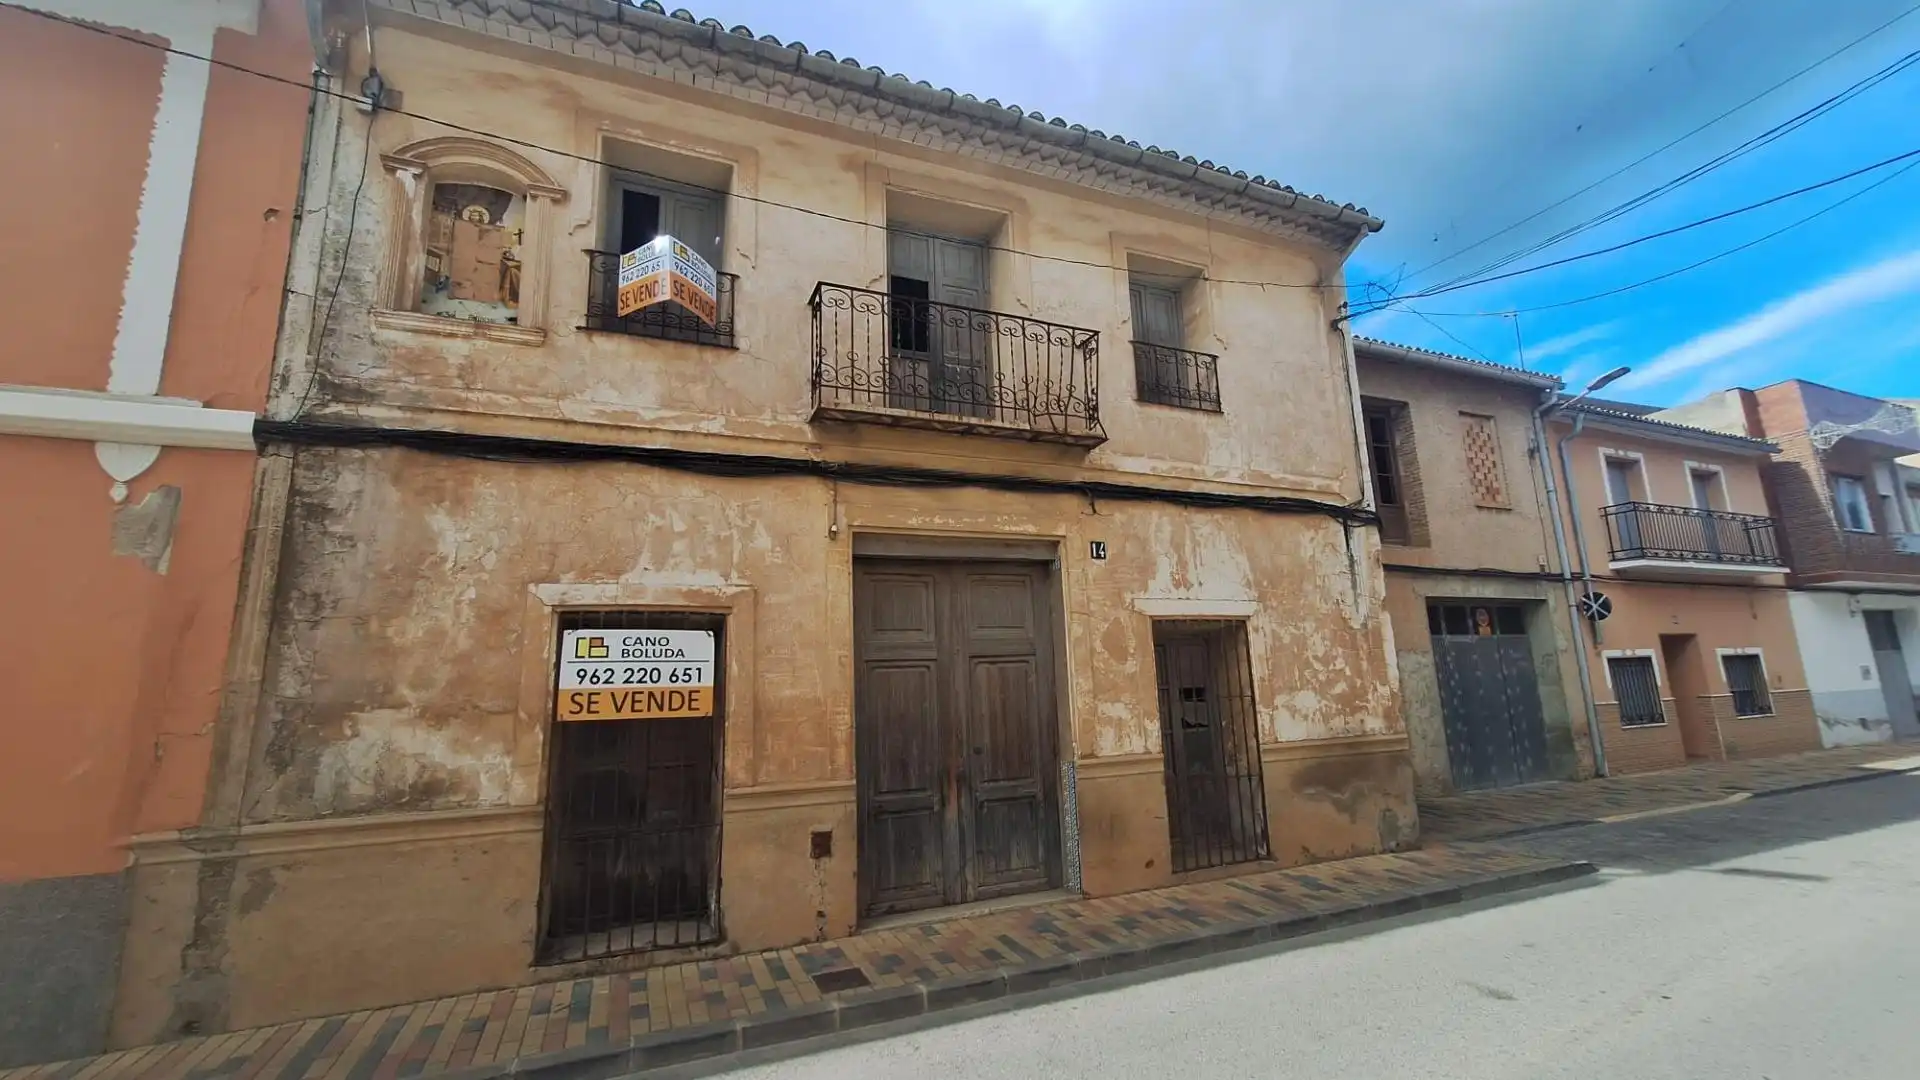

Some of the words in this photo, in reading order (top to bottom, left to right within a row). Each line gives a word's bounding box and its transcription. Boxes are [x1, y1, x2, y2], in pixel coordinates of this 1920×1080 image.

[622, 270, 634, 284] 962
[635, 265, 650, 279] 220
[674, 261, 688, 278] 962
[690, 271, 703, 287] 220
[620, 291, 631, 310] SE
[631, 278, 666, 304] VENDE
[673, 280, 686, 301] SE
[687, 287, 715, 321] VENDE
[1092, 542, 1105, 558] 14
[622, 636, 670, 647] CANO
[621, 648, 686, 659] BOLUDA
[576, 667, 615, 685] 962
[622, 667, 661, 684] 220
[668, 667, 702, 683] 651
[569, 691, 602, 715] SE
[610, 690, 701, 714] VENDE
